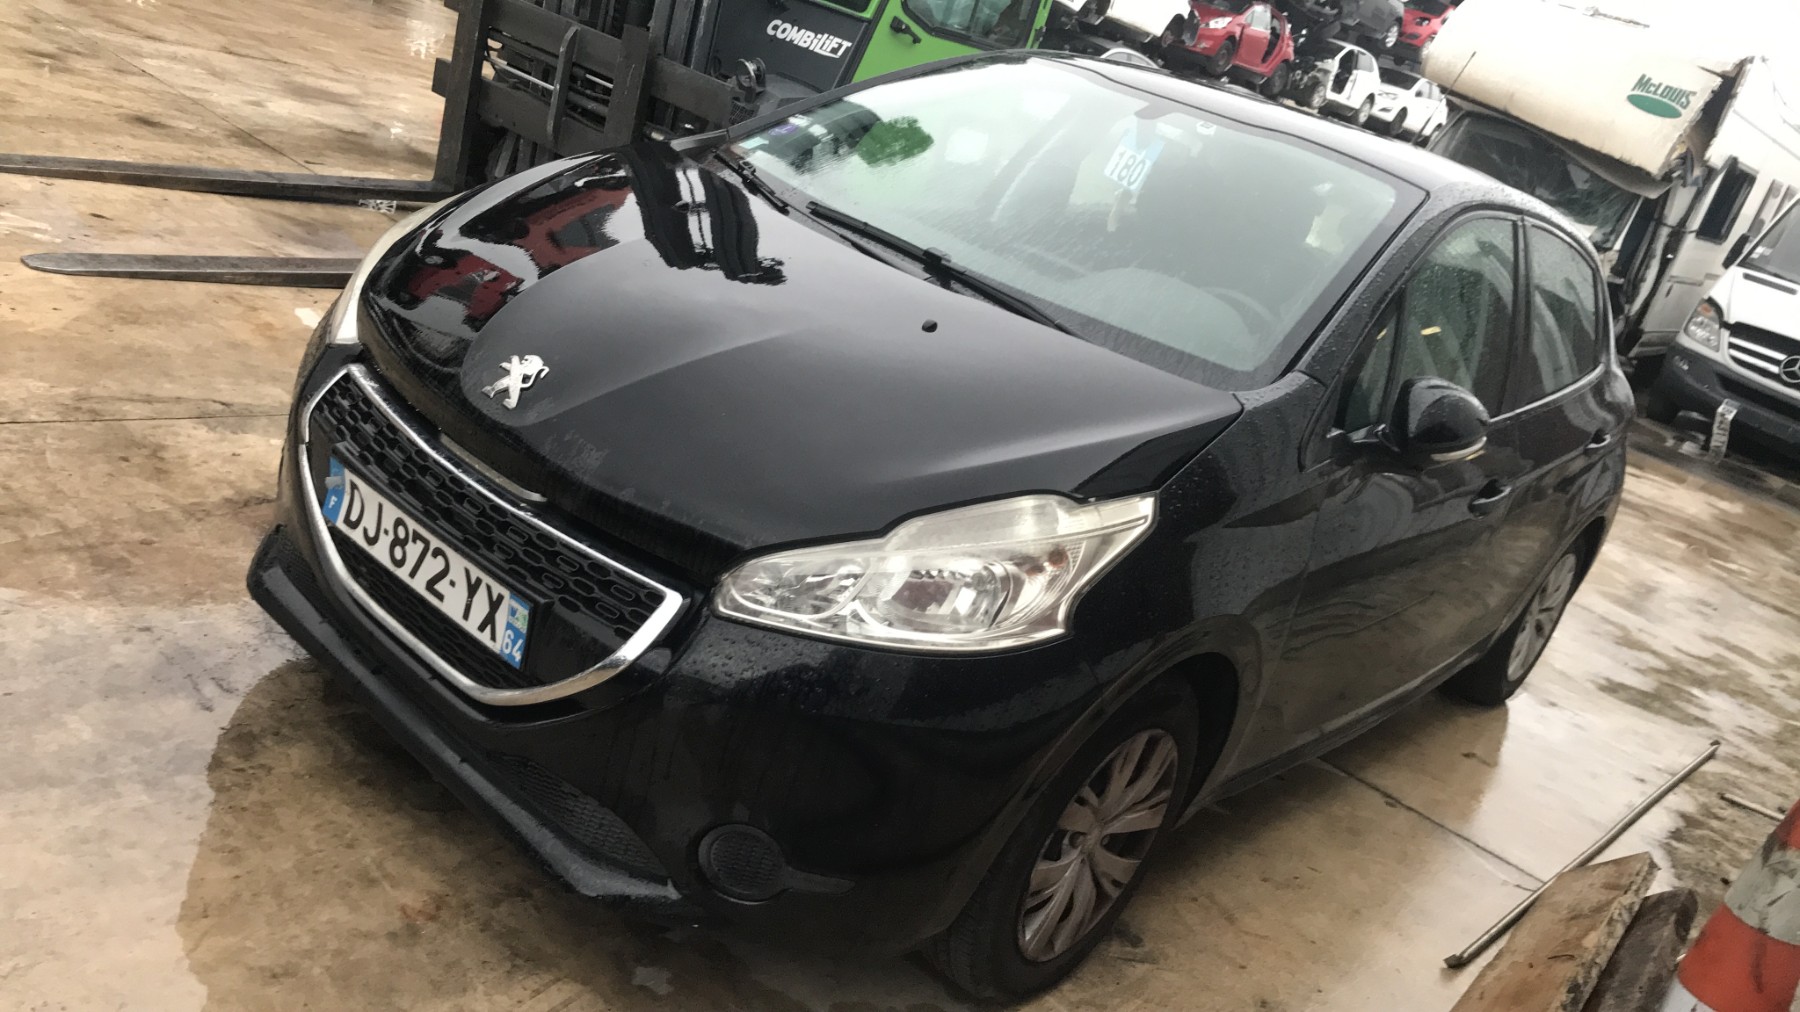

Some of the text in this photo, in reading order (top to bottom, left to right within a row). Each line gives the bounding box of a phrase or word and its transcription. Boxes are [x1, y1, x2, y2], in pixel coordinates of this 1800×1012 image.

[1110, 150, 1146, 187] 180
[328, 495, 338, 509] F
[502, 629, 524, 662] 64
